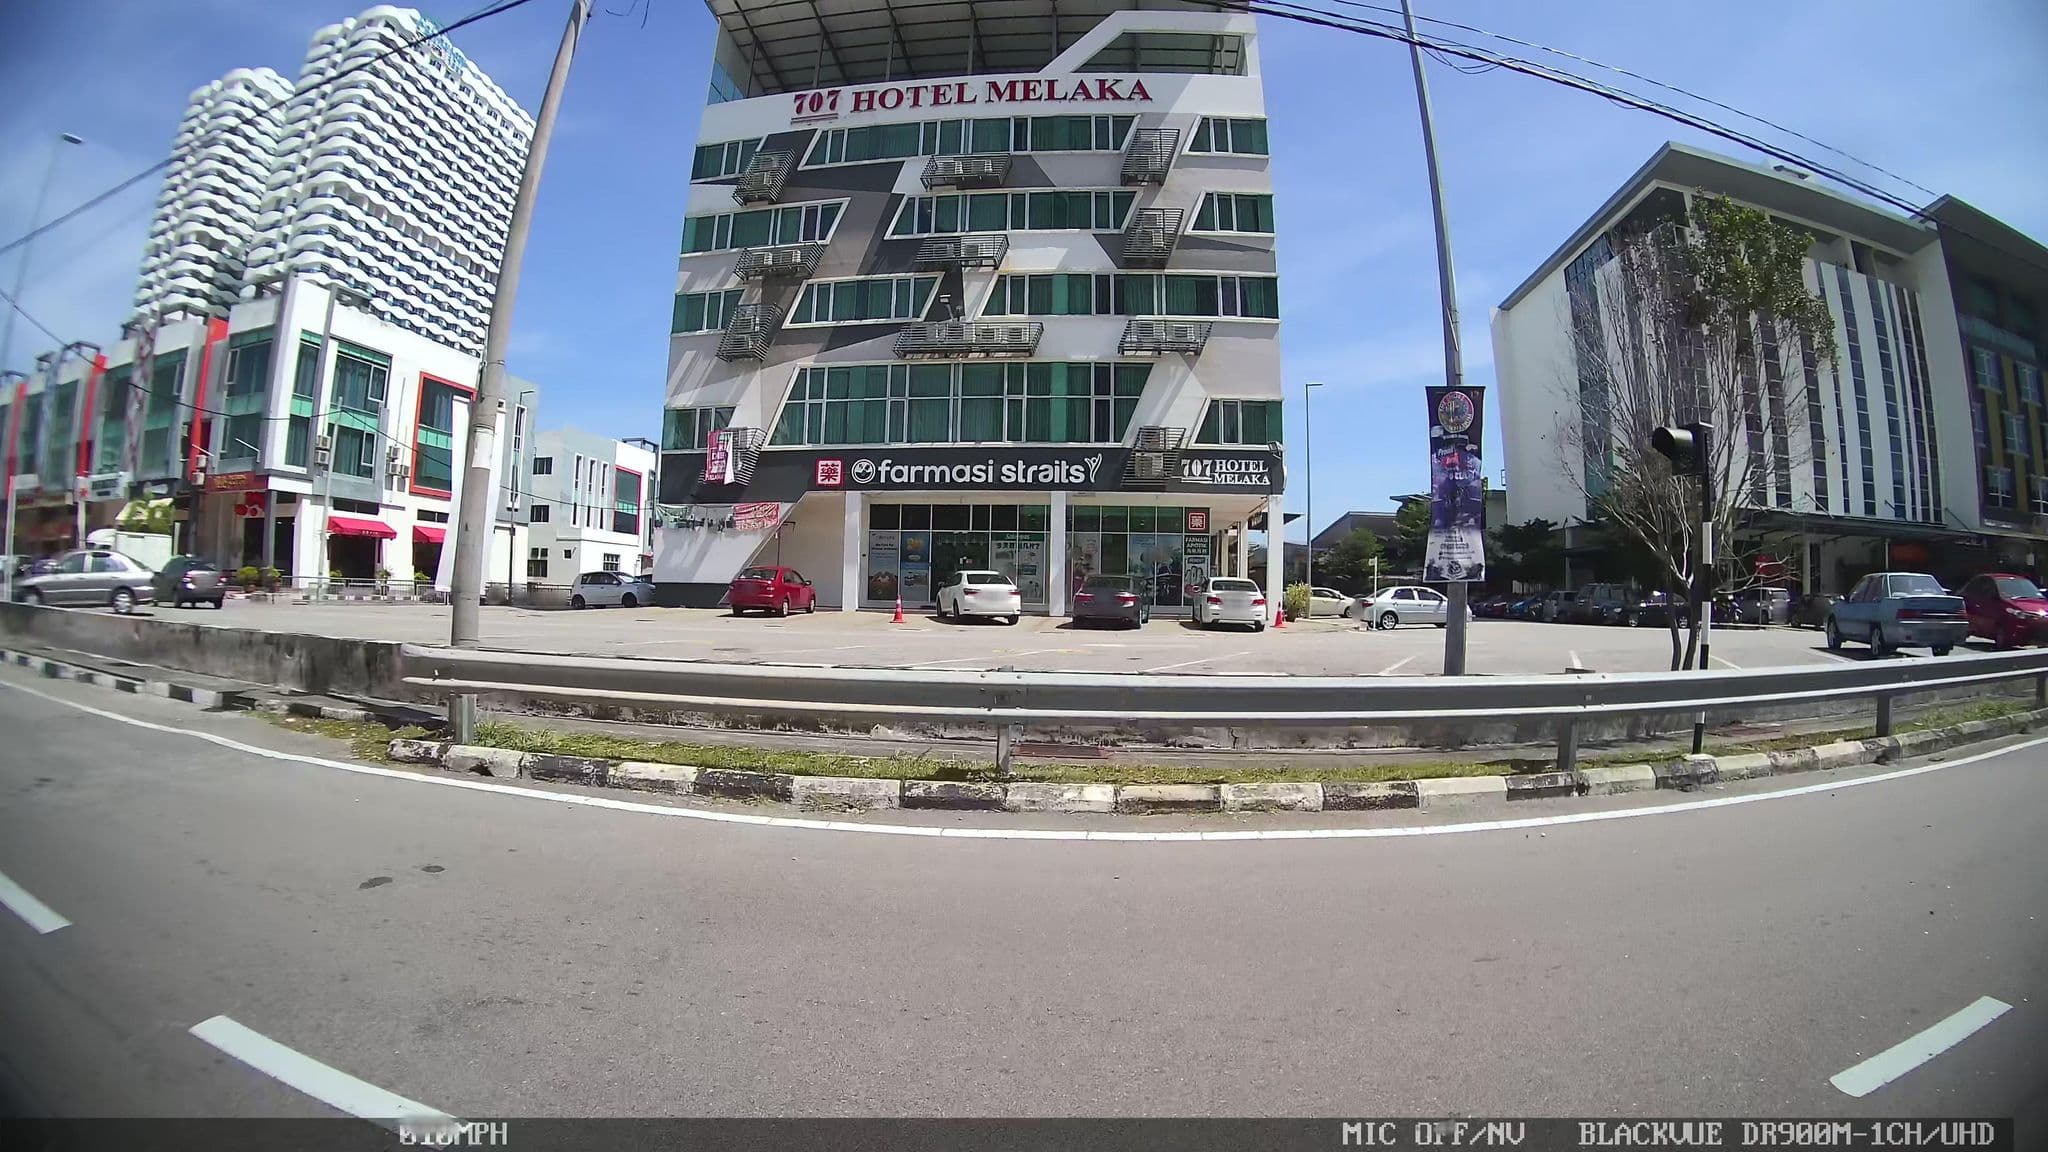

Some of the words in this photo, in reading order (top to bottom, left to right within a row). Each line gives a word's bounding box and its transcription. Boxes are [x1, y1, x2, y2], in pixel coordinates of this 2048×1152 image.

[794, 89, 841, 116] 707
[850, 82, 977, 113] HOTEL
[985, 78, 1153, 104] MELAKA
[878, 459, 994, 483] farmasi
[1001, 459, 1085, 483] straits
[1181, 459, 1212, 478] 707
[1214, 459, 1269, 473] HOTEL
[1212, 473, 1271, 485] MELAKA
